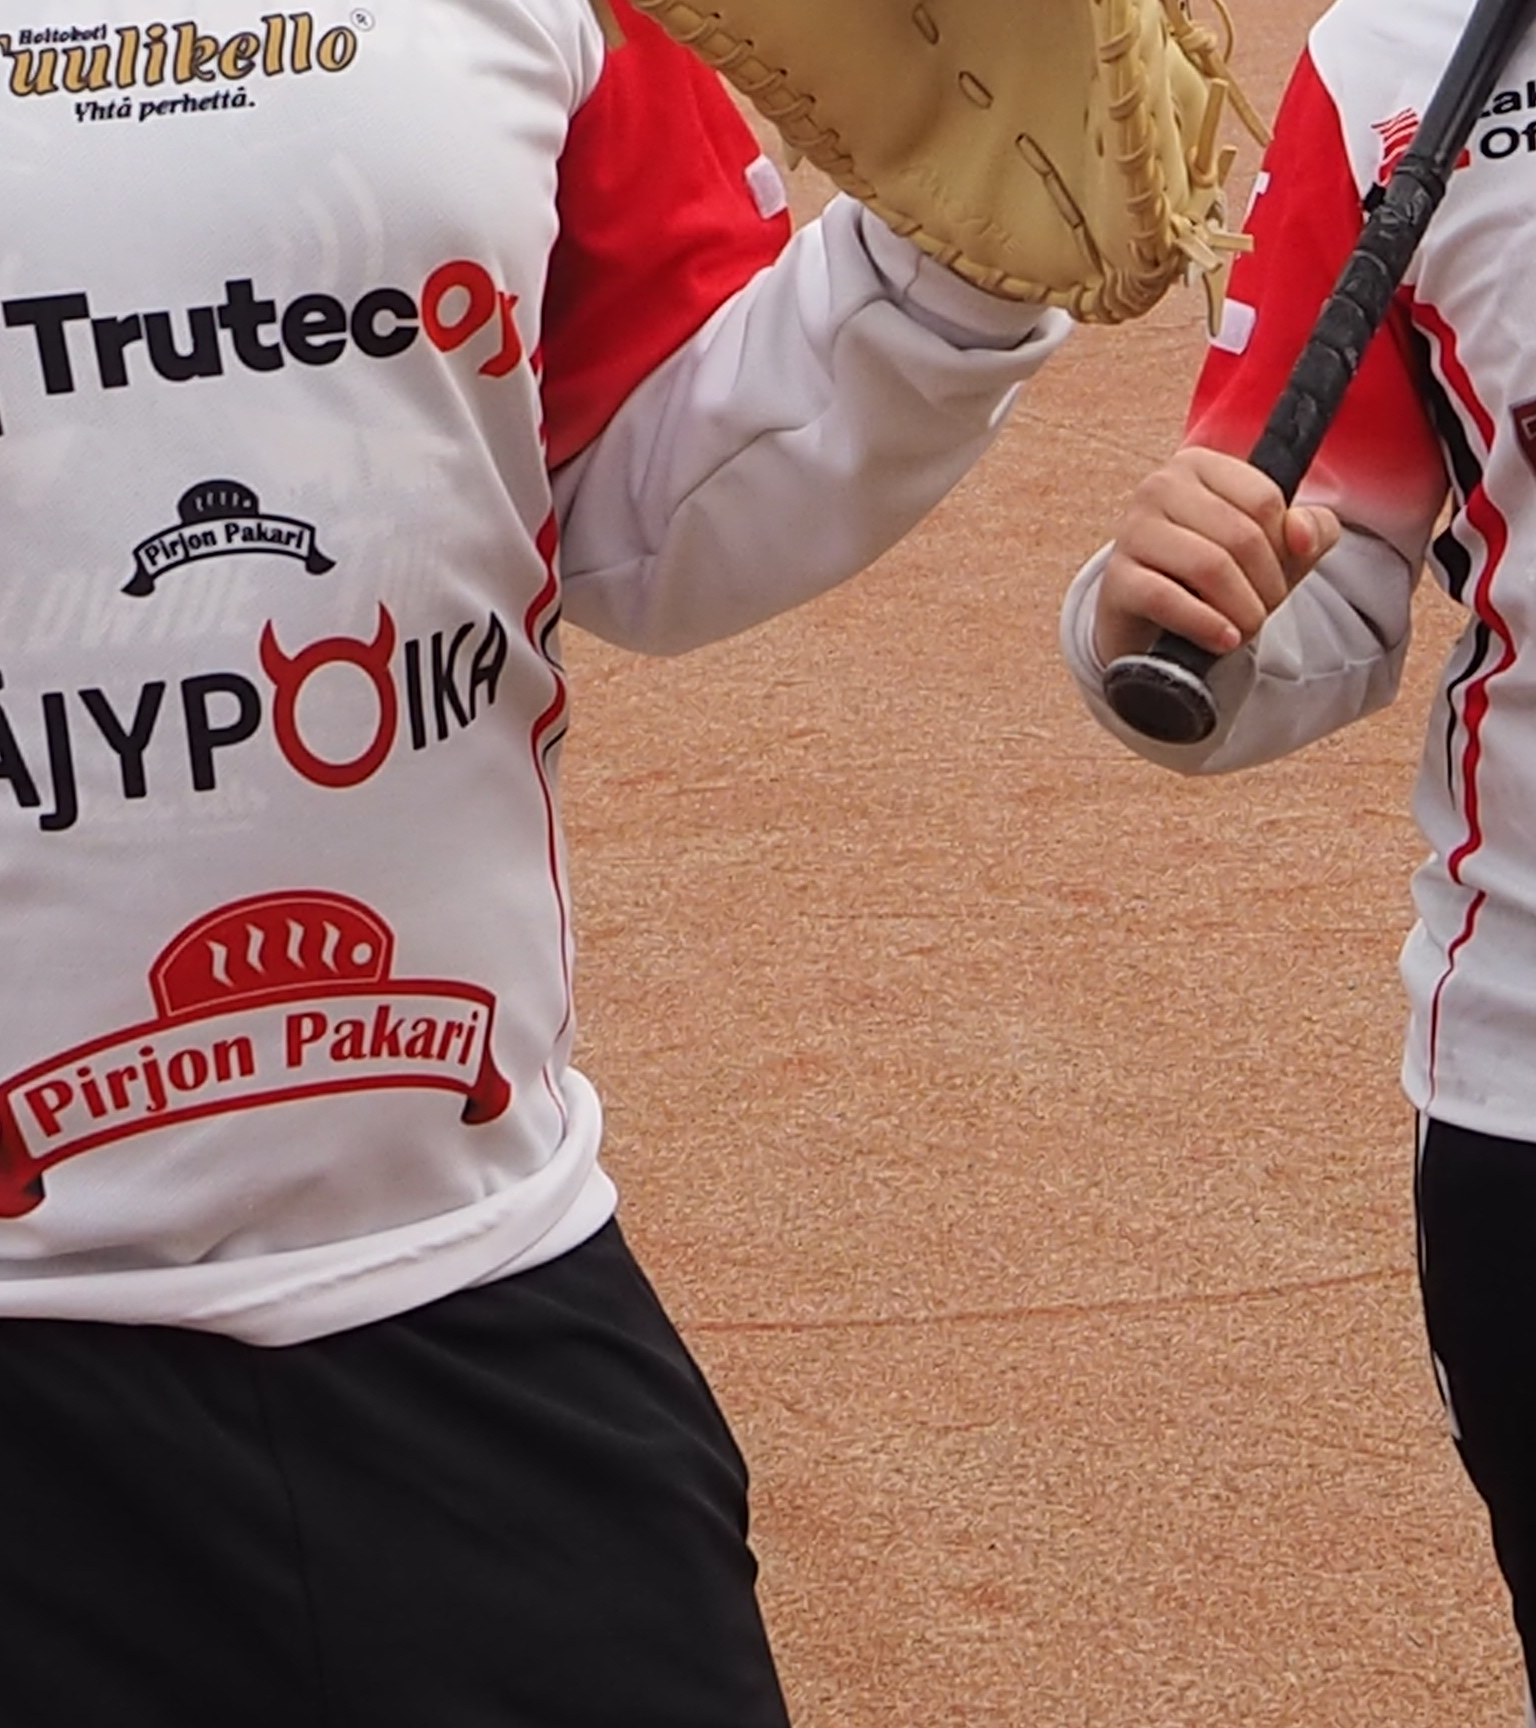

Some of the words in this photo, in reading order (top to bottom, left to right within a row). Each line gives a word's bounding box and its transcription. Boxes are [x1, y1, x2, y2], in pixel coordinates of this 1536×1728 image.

[75, 94, 132, 122] Yhtä
[144, 530, 217, 567] Pirjon
[224, 522, 305, 549] Pakari
[22, 1035, 257, 1140] Pirjon
[285, 1004, 482, 1070] Pakari
